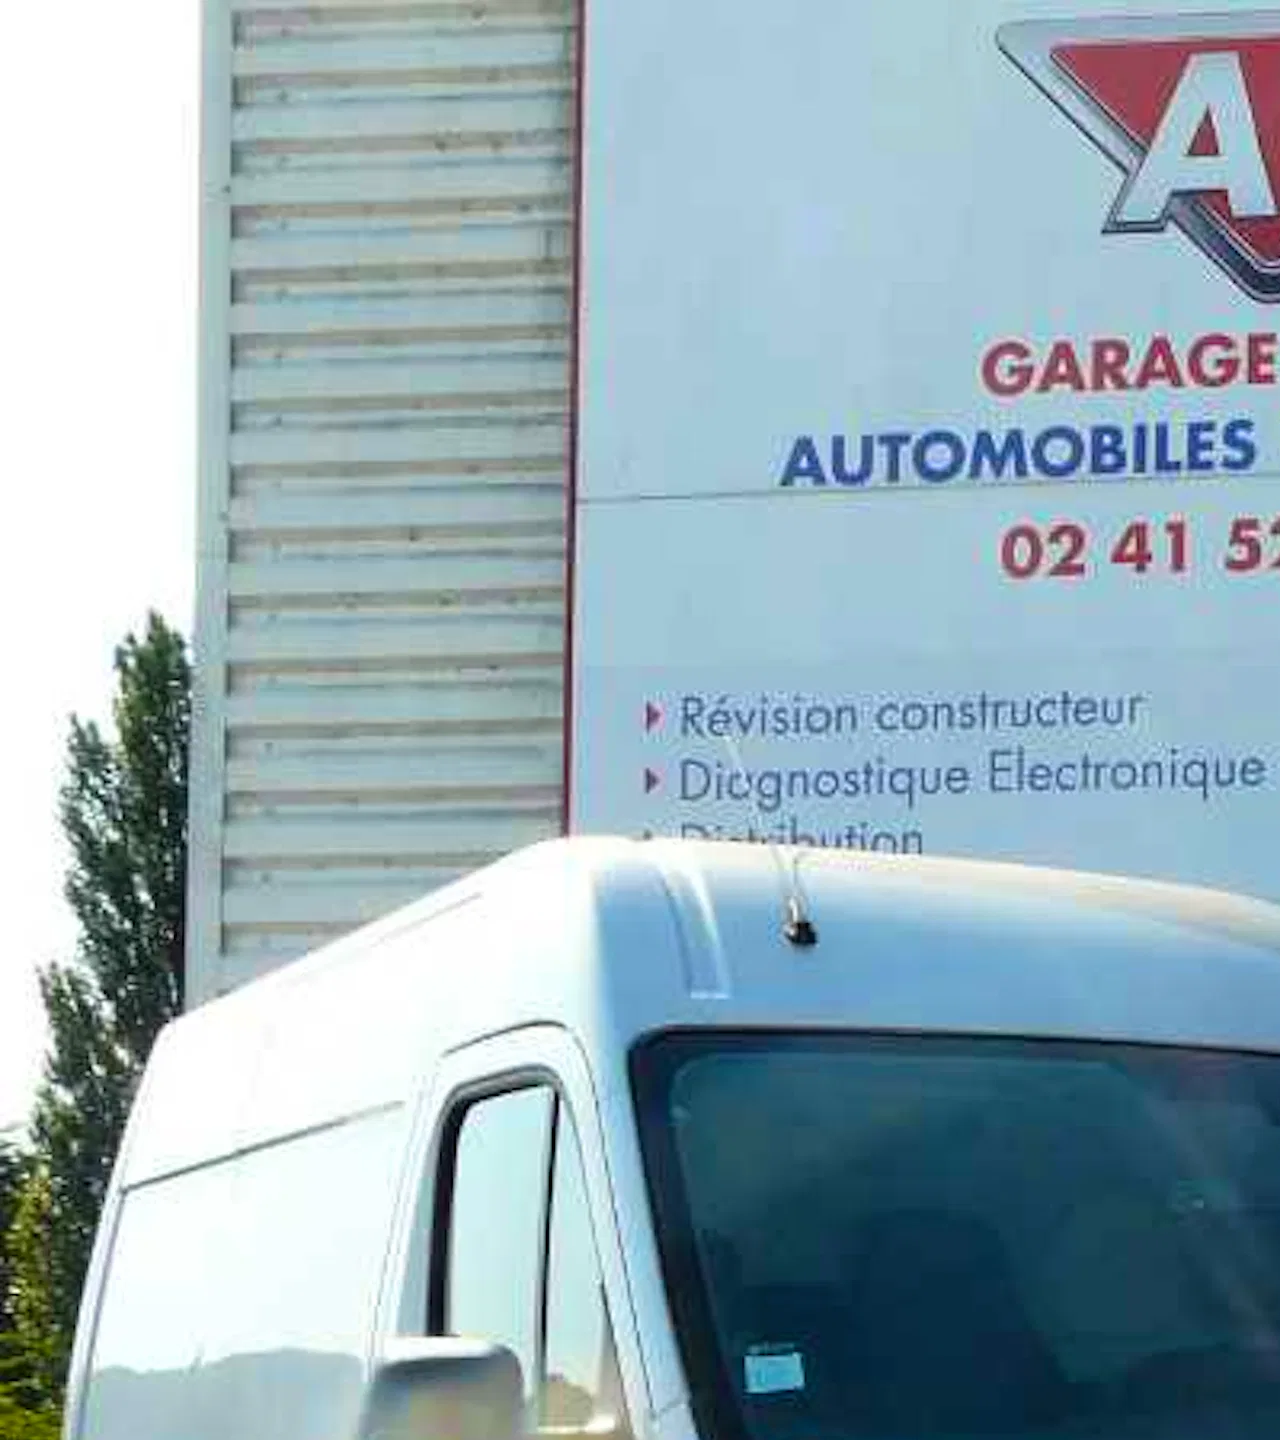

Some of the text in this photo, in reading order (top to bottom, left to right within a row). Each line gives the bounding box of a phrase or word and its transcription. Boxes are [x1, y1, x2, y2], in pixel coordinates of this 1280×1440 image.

[980, 333, 1279, 396] GARAGE
[780, 419, 1255, 487] AUTOMOBILES
[1001, 524, 1086, 578] 02
[1112, 520, 1186, 572] 41
[680, 690, 1144, 742] Révision constructeur
[679, 748, 1269, 812] Diagnostique Electronique
